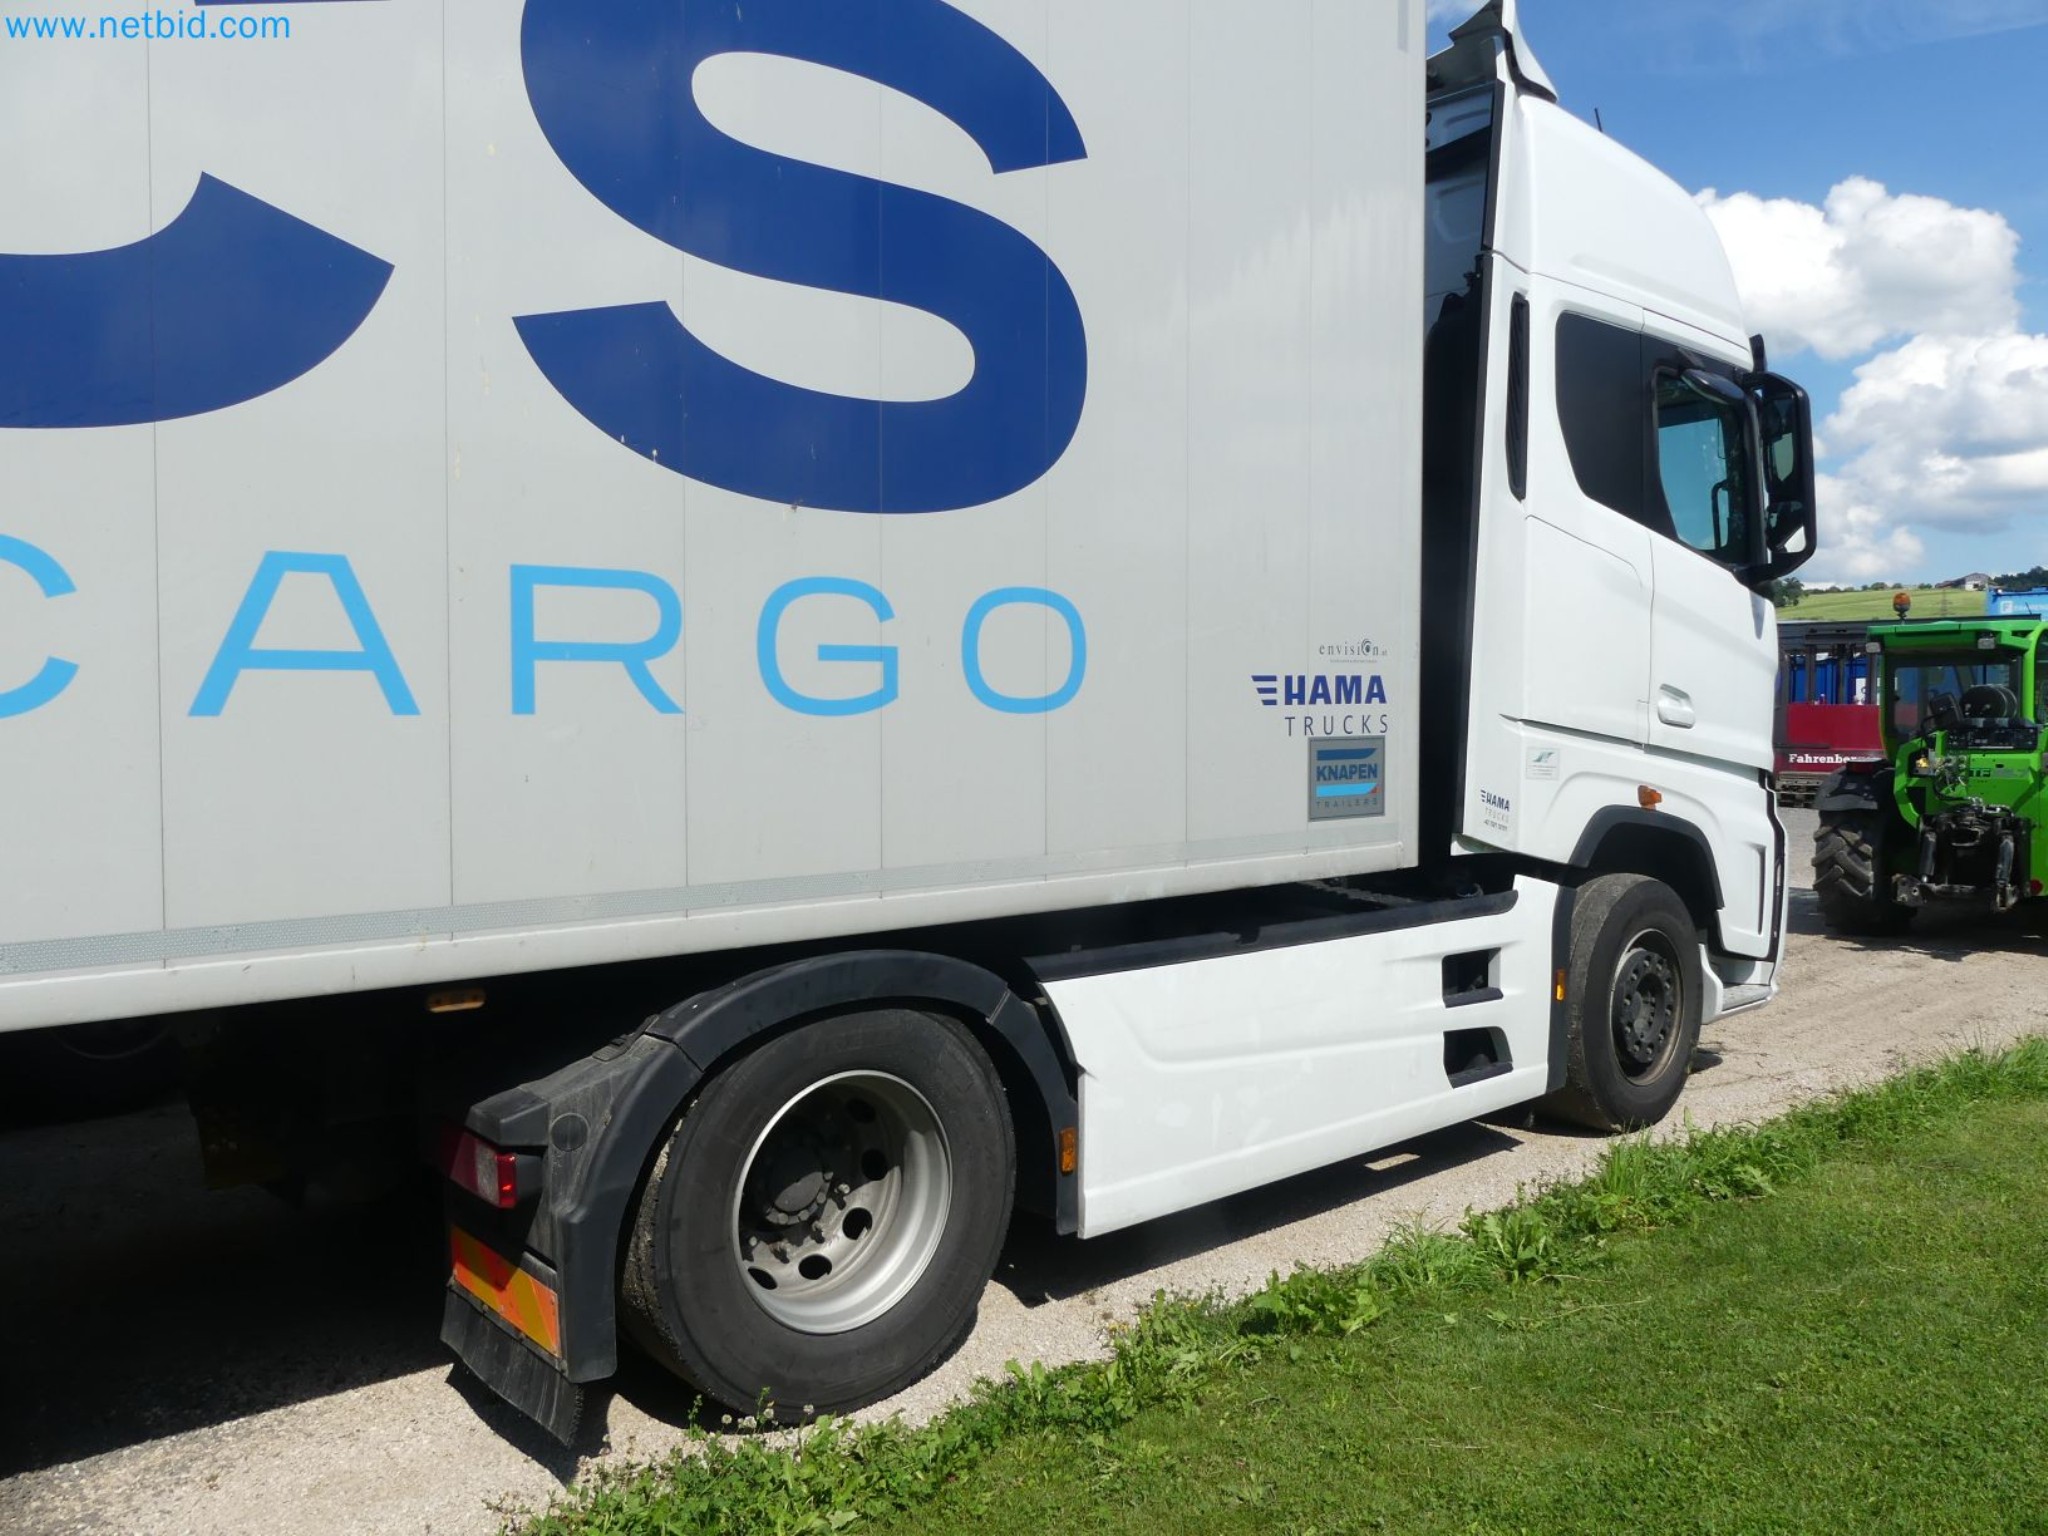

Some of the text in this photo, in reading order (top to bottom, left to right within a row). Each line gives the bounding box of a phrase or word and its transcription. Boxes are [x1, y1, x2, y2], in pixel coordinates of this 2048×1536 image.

[1284, 674, 1388, 705] HAMA
[1284, 714, 1389, 737] TRUCKS
[1316, 763, 1378, 781] KNAPEN
[1316, 798, 1378, 809] TRAILERS
[1486, 792, 1510, 812] HAMA
